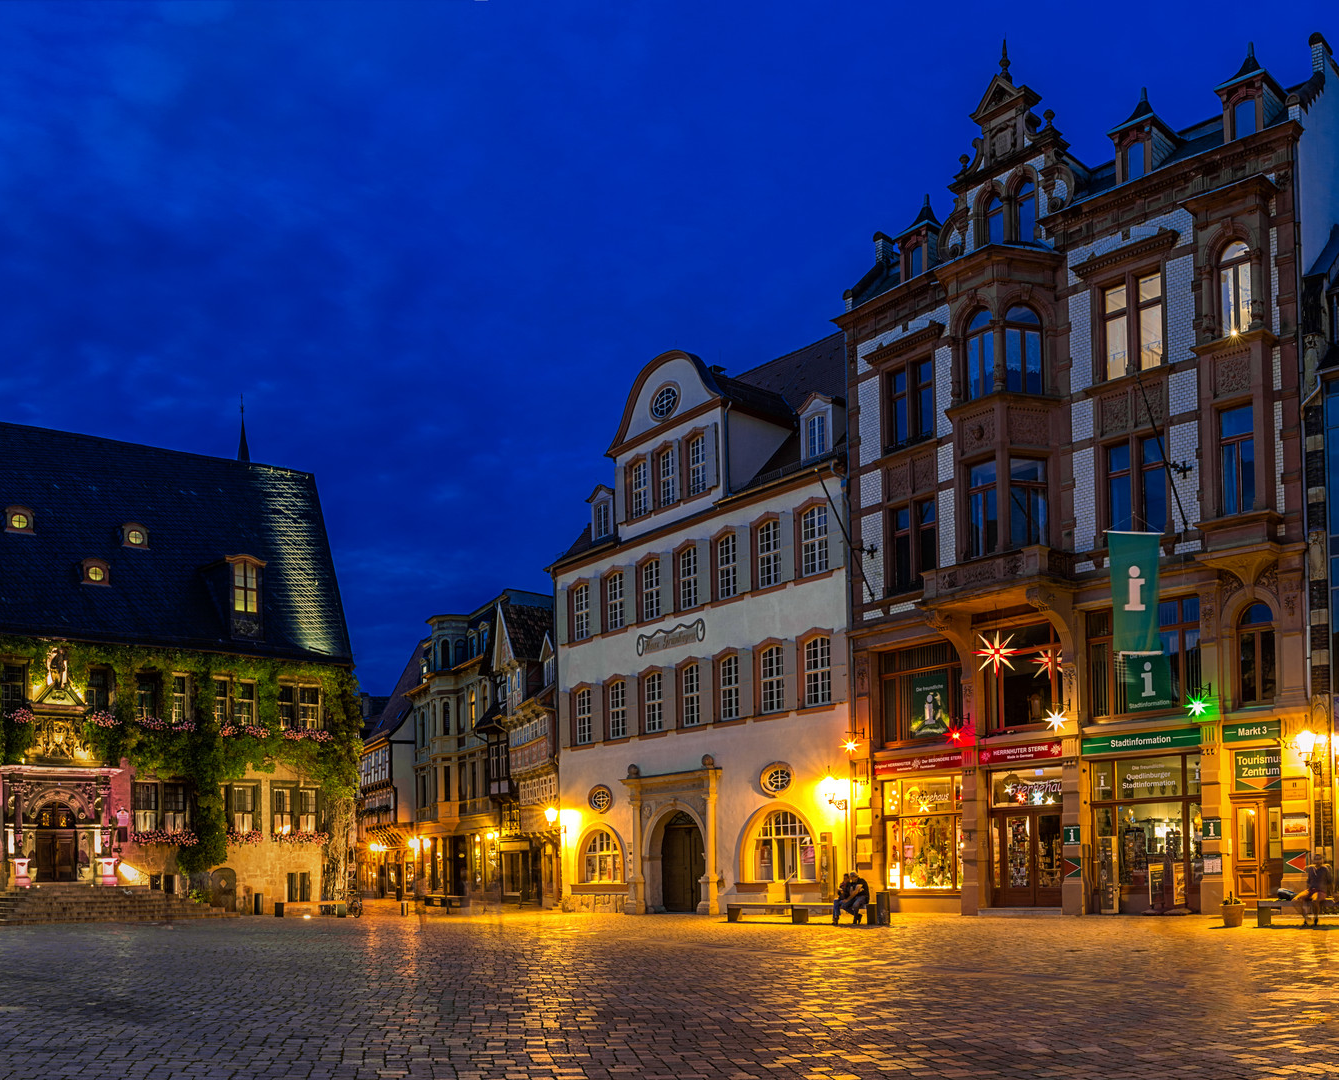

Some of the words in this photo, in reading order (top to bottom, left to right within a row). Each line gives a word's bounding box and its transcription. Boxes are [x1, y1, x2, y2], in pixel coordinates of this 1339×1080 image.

[1141, 661, 1156, 697] i
[1129, 699, 1170, 709] Stadtinformation
[1237, 727, 1261, 736] Markt
[1262, 726, 1267, 734] 3
[1110, 735, 1171, 748] Stadtinformation
[993, 747, 1027, 756] HERRNHUTER
[1028, 745, 1048, 753] STERNE
[1126, 771, 1171, 781] Quedlinburger
[1242, 767, 1280, 777] Zentrum
[1122, 780, 1176, 789] Stadtinformation
[910, 792, 950, 803] Sternehaus
